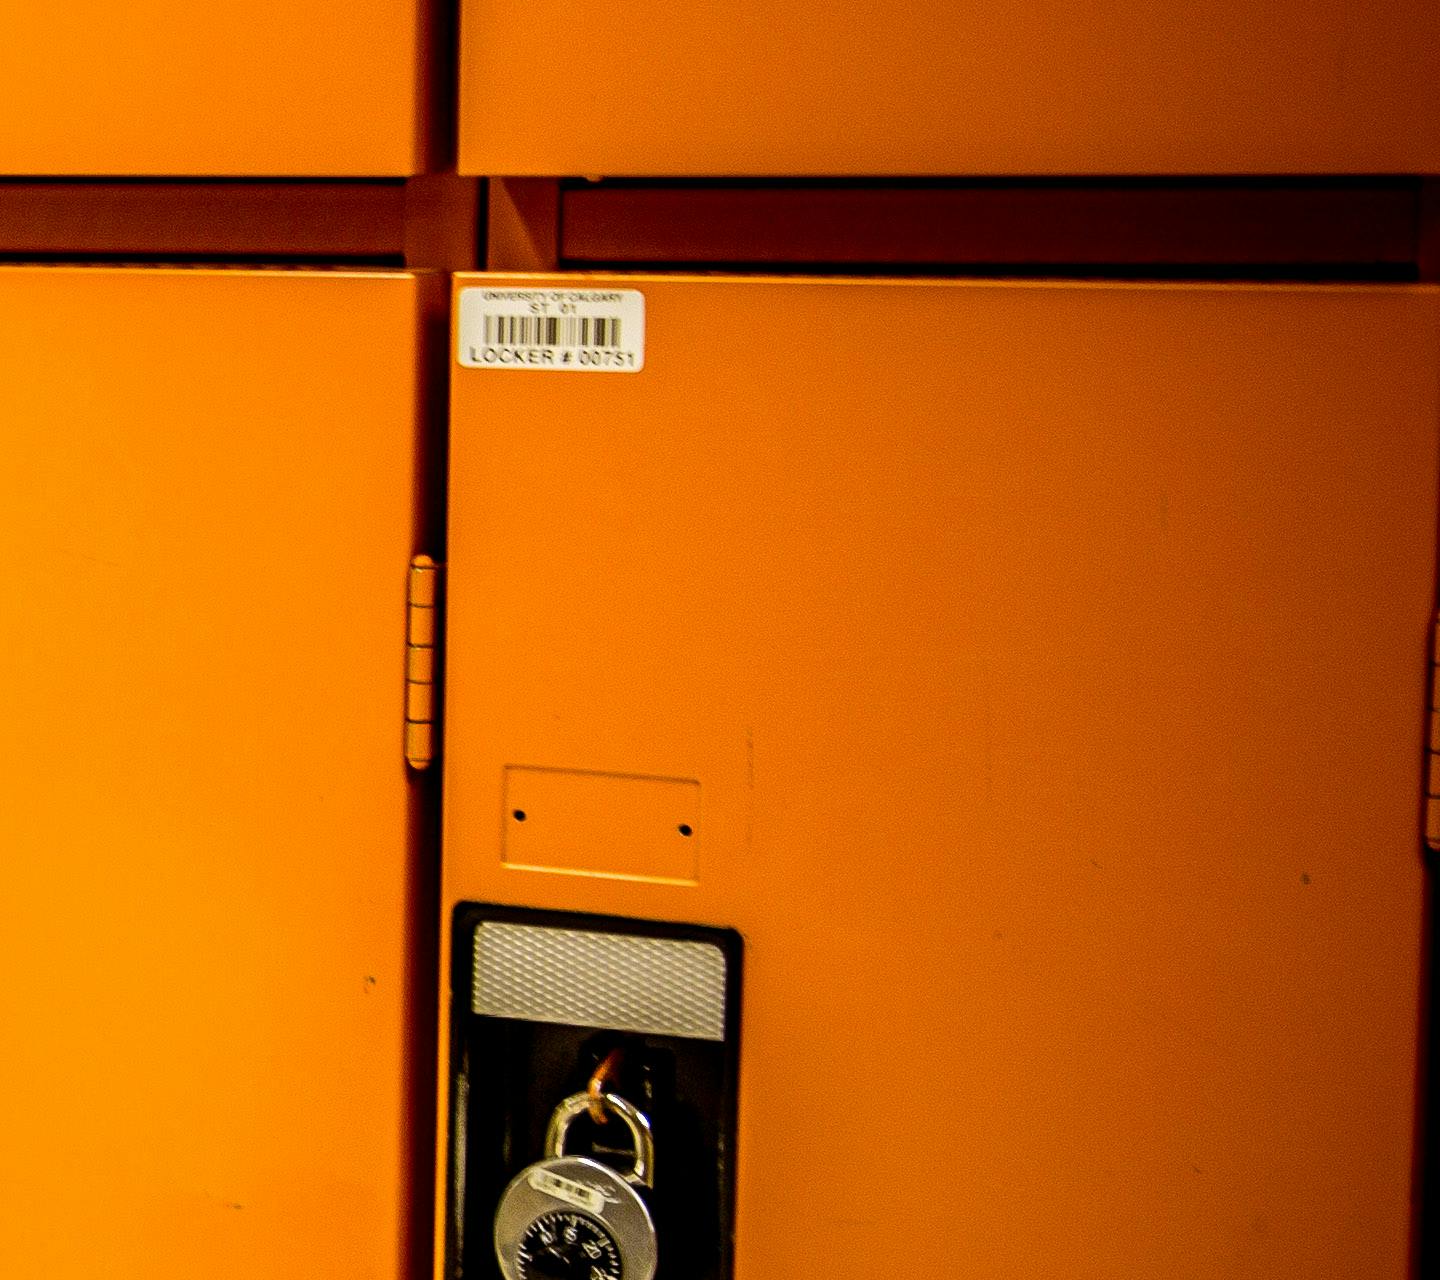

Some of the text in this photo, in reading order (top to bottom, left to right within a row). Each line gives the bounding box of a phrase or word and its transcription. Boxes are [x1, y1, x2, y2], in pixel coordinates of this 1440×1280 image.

[482, 290, 623, 303] UNIVERSITY OF CALGARY
[530, 303, 578, 315] ST 01
[469, 346, 635, 367] LOCKER # 00751
